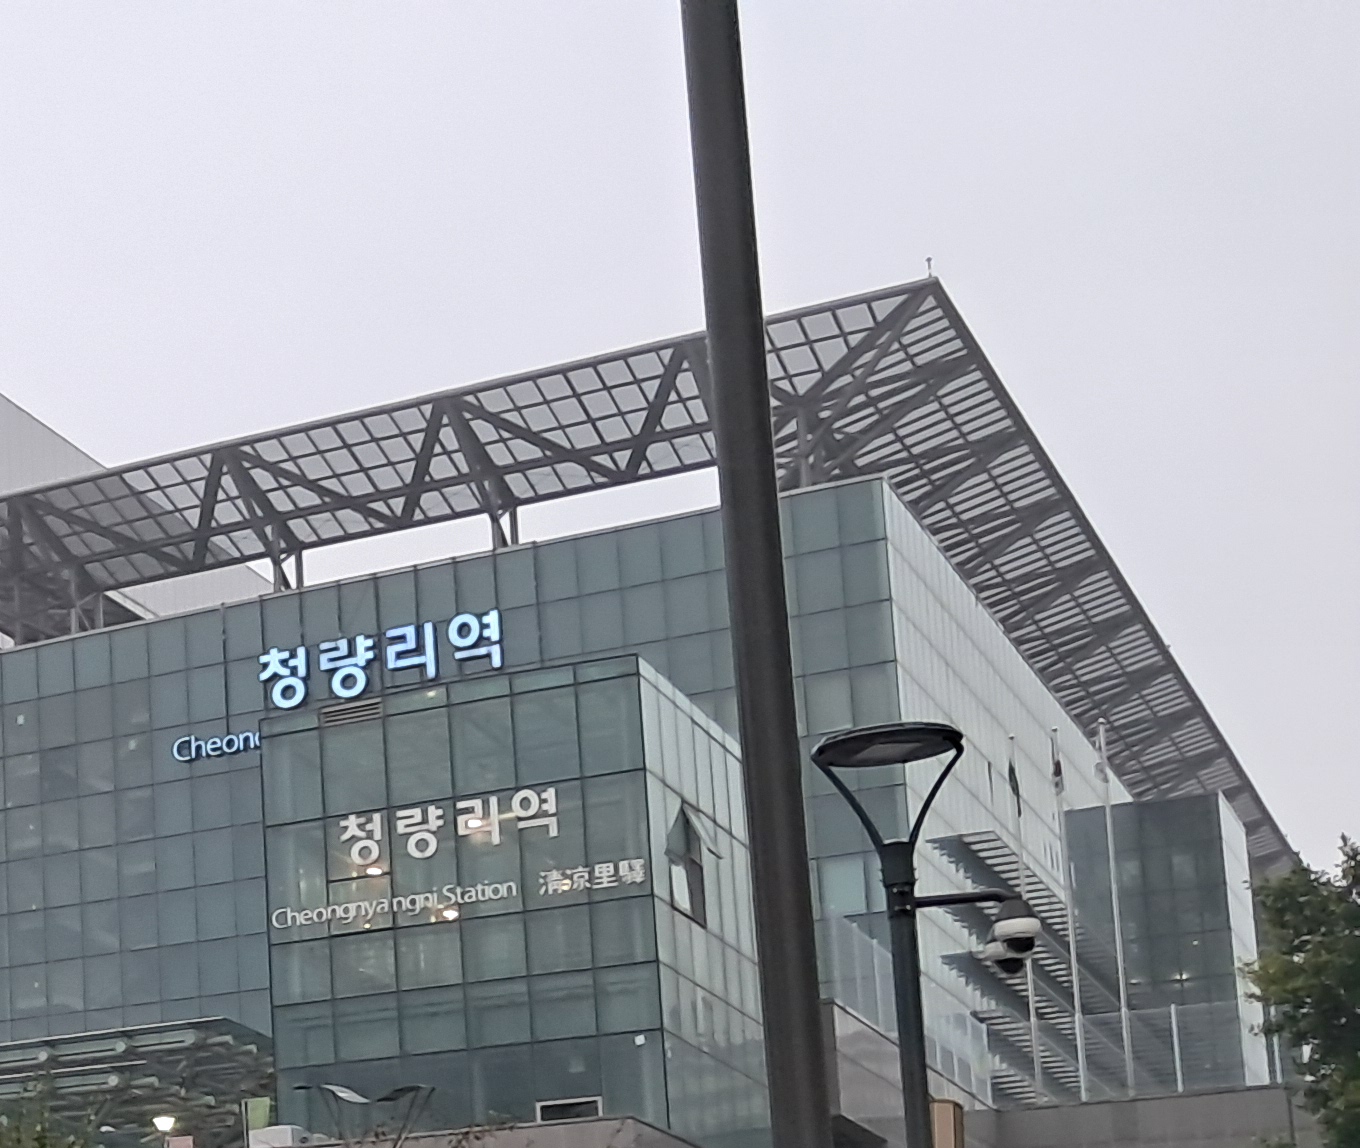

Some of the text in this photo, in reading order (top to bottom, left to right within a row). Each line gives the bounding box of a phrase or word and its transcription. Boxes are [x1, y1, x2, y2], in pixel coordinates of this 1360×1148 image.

[258, 608, 504, 710] 청량리역
[172, 730, 261, 763] Cheon
[338, 786, 561, 866] 청량리역
[270, 879, 518, 931] Cheongnyangni Station
